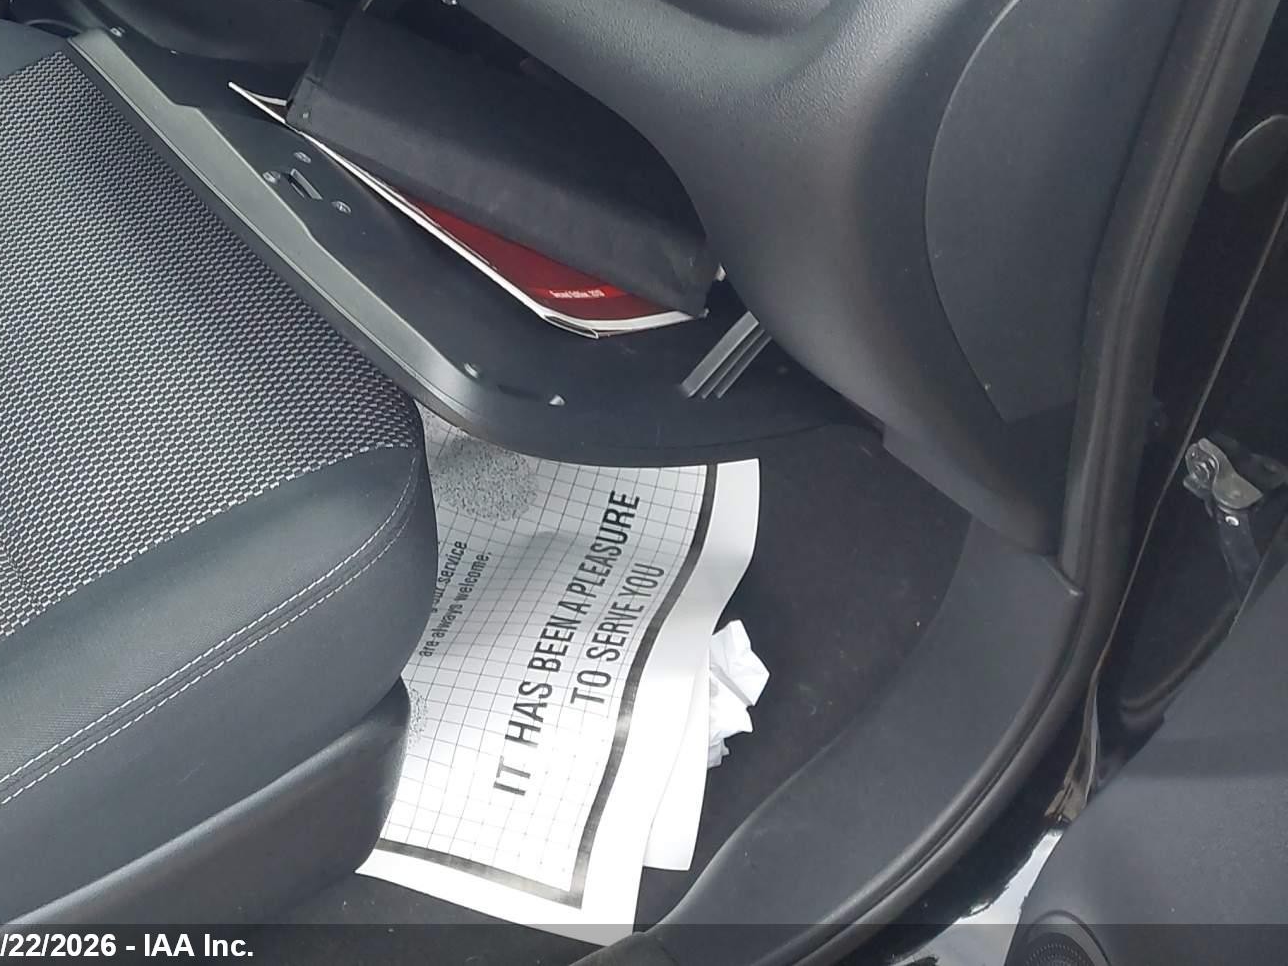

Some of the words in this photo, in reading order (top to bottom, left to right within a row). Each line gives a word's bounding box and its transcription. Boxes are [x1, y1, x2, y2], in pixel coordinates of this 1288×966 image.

[438, 540, 468, 584] service
[566, 490, 641, 599] PLEASURE
[618, 562, 665, 598] YOU
[419, 639, 440, 657] are
[431, 603, 463, 638] always
[557, 600, 592, 615] A
[585, 601, 645, 662] SERVE
[527, 614, 582, 673] BEEN
[570, 669, 612, 704] TO
[504, 680, 553, 748] HAS
[492, 754, 532, 796] IT
